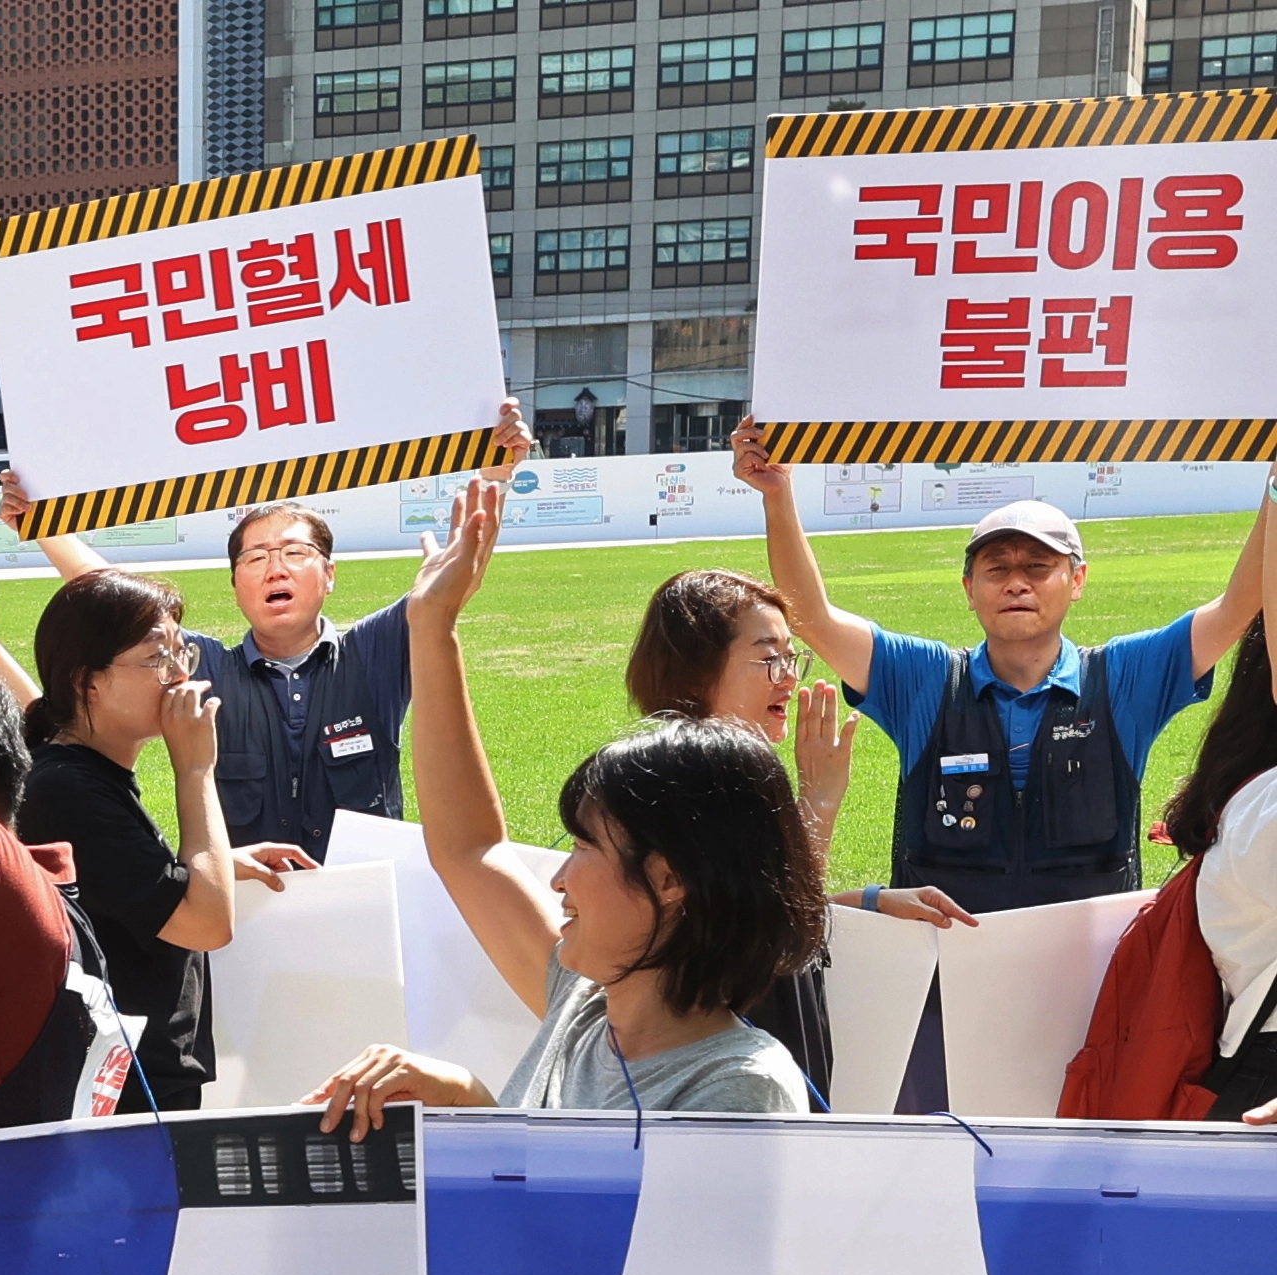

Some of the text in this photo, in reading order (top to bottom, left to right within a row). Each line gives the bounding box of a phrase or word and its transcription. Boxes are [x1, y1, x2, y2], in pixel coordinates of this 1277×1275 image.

[853, 174, 1245, 277] 국민이용
[69, 218, 411, 349] 국민혈세
[165, 338, 336, 445] 낭비
[940, 295, 1133, 390] 불편
